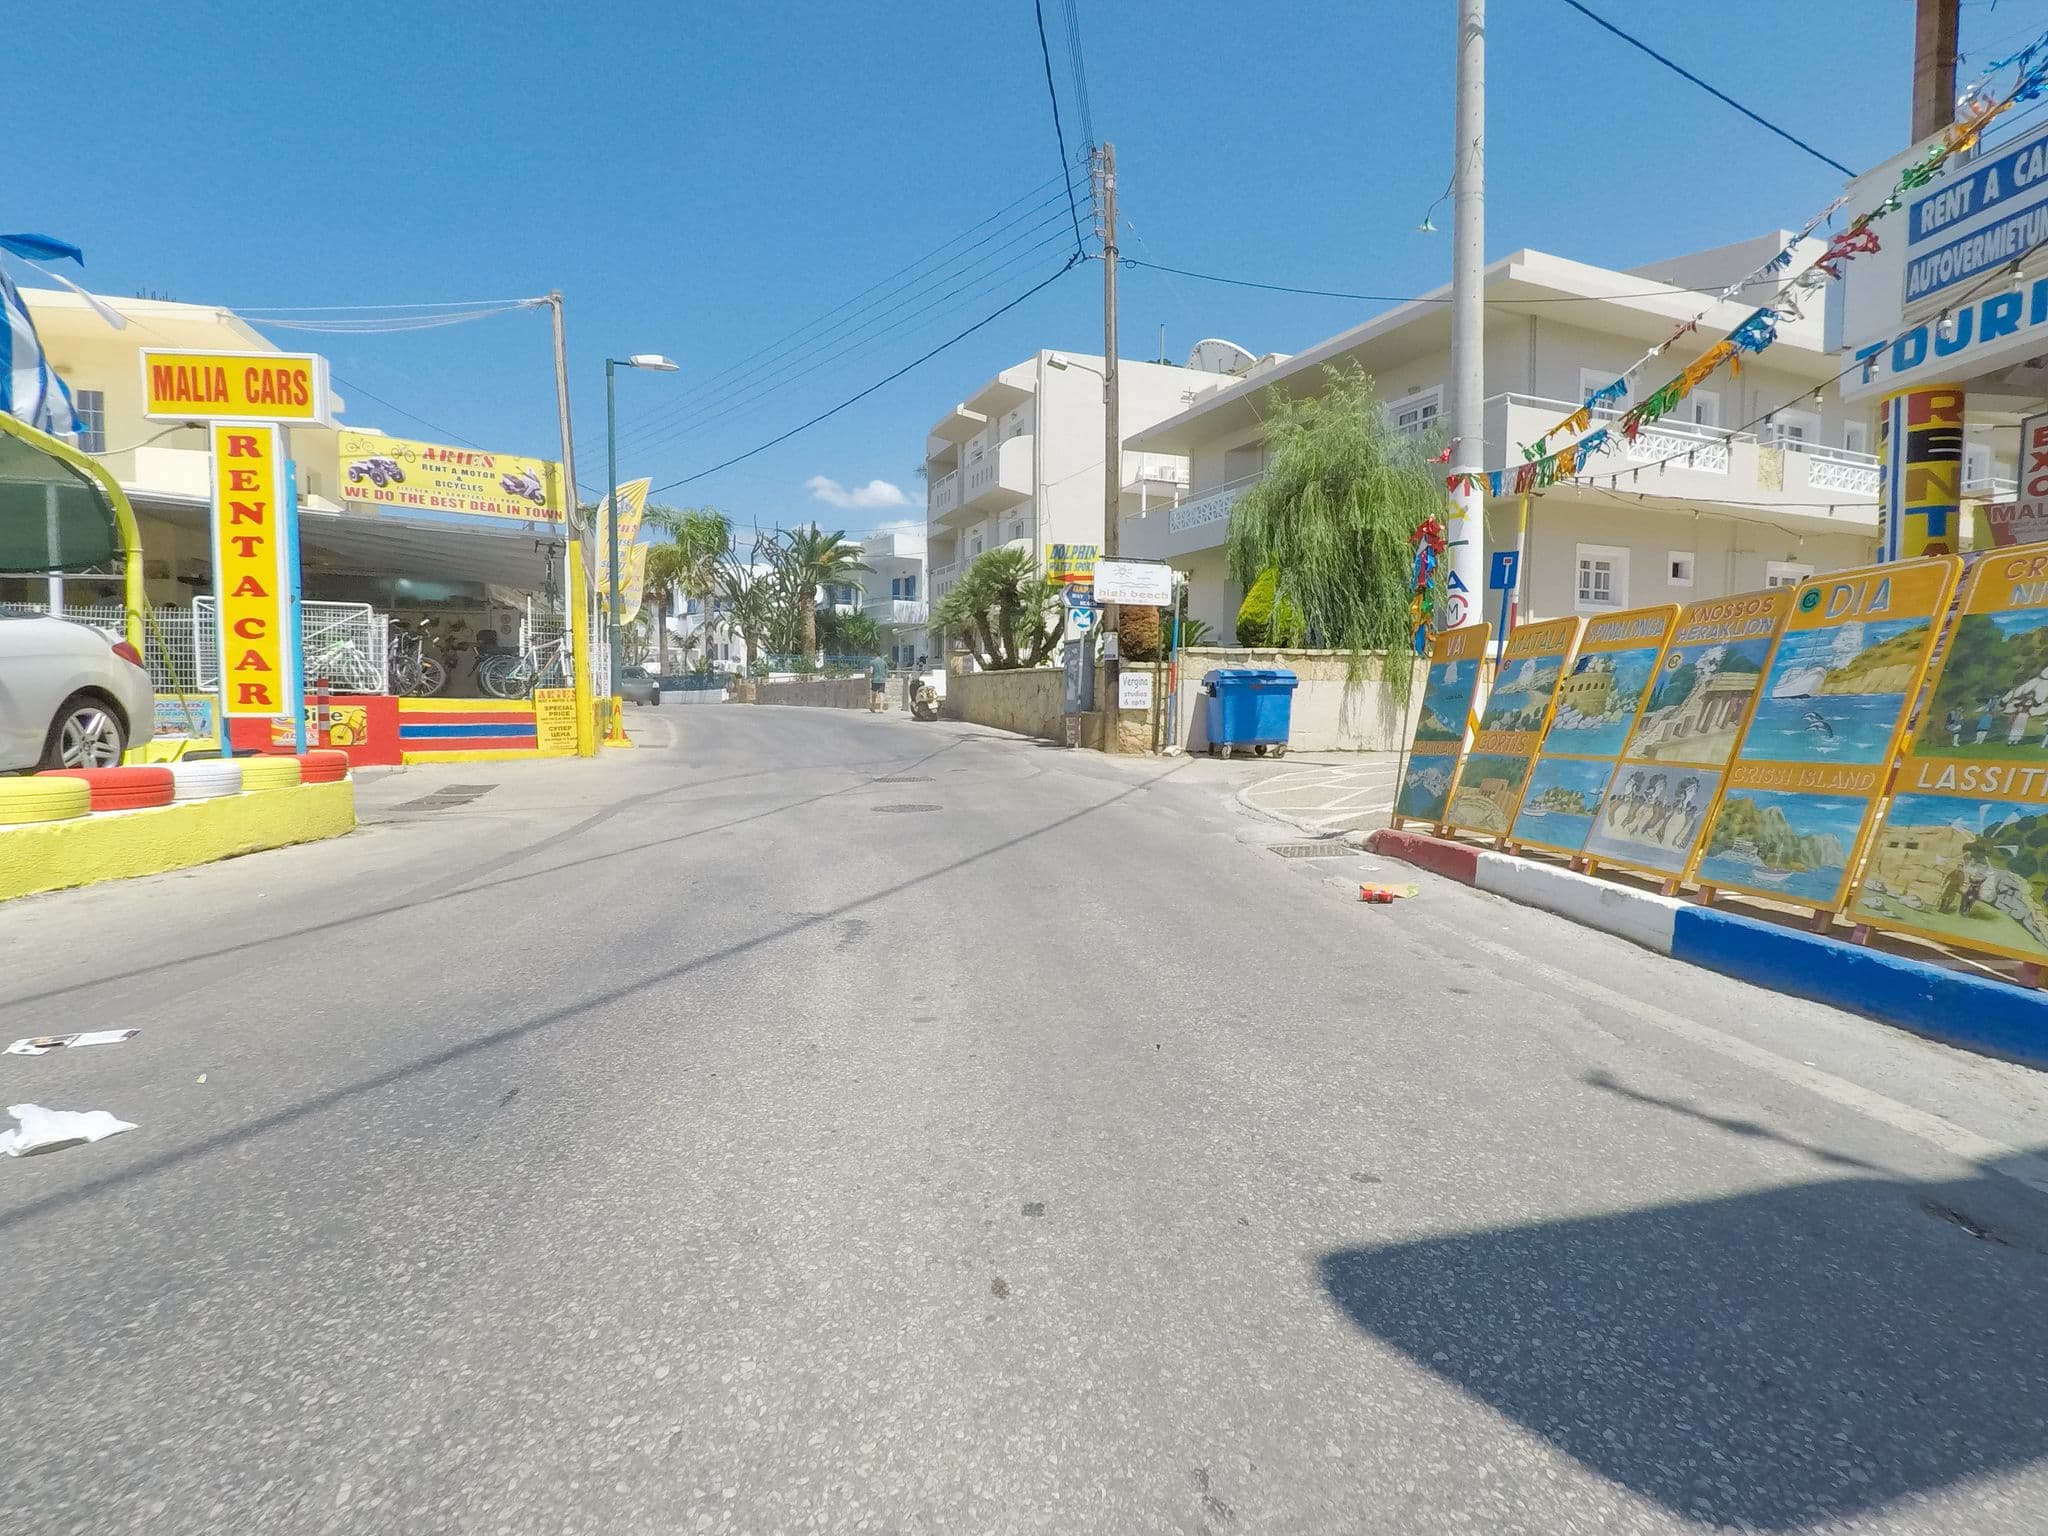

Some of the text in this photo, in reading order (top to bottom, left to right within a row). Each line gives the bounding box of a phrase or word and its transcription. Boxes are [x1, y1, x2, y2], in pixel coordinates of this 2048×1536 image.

[1921, 180, 1974, 234] RENT
[1983, 168, 1998, 204] A
[153, 365, 308, 406] MALIA CARS
[422, 463, 447, 472] RENT
[461, 469, 495, 479] MOTOR
[435, 480, 484, 492] BICYCLES
[345, 486, 368, 499] WE
[374, 489, 394, 502] DO
[400, 492, 426, 505] THE
[430, 496, 465, 509] BEST
[470, 499, 503, 514] DEAL
[507, 501, 520, 516] IN
[525, 506, 563, 521] TOWN
[1050, 544, 1098, 559] DOLPHIN
[227, 434, 272, 705] RENT A CAR
[1688, 597, 1775, 625] KNOSSOS
[1825, 577, 1892, 619] DIA
[1511, 627, 1568, 653] MATALA
[1676, 616, 1777, 643] HERAKLION
[1446, 634, 1467, 656] VAI
[1122, 675, 1149, 690] Vergina
[1478, 735, 1530, 753] GORTIS
[1797, 769, 1876, 791] ISLAND
[1916, 761, 2048, 798] LASSIT
